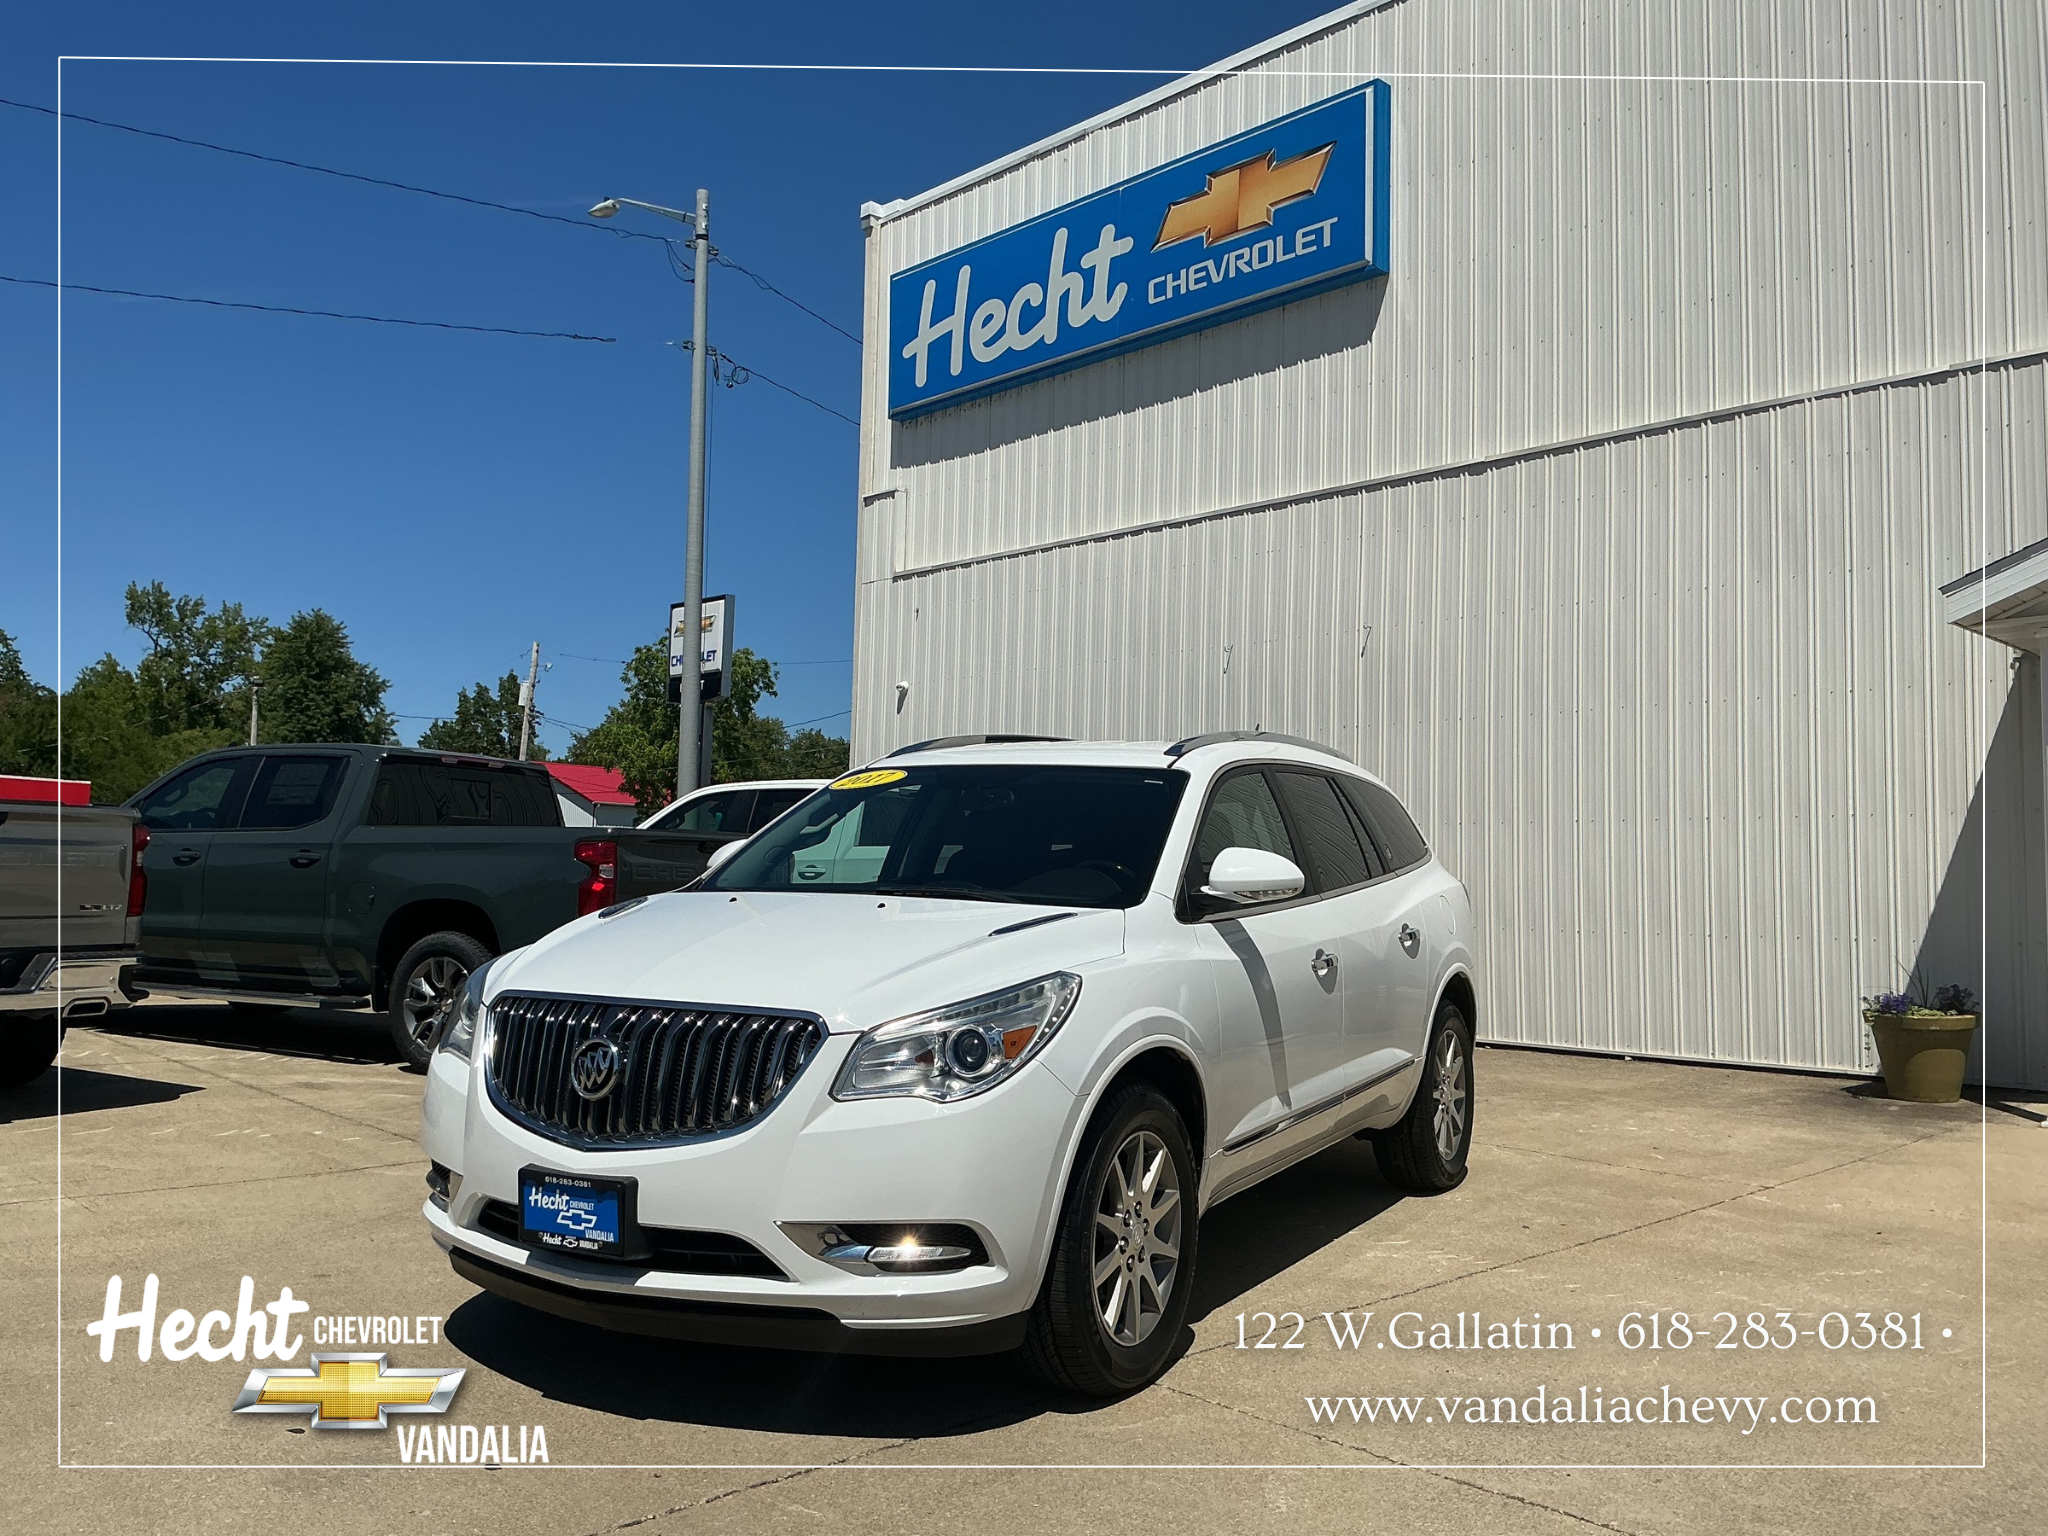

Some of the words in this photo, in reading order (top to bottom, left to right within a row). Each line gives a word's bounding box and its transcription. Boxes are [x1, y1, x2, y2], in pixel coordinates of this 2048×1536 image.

[902, 223, 1134, 388] Hecht
[1147, 216, 1339, 305] CHEVROLET
[671, 649, 717, 667] CHLET
[545, 1175, 592, 1188] 618-283-0381
[529, 1185, 570, 1211] Hecht
[569, 1200, 594, 1211] CHEVROLET
[542, 1232, 562, 1246] Hecht
[584, 1228, 615, 1242] VANDALIA
